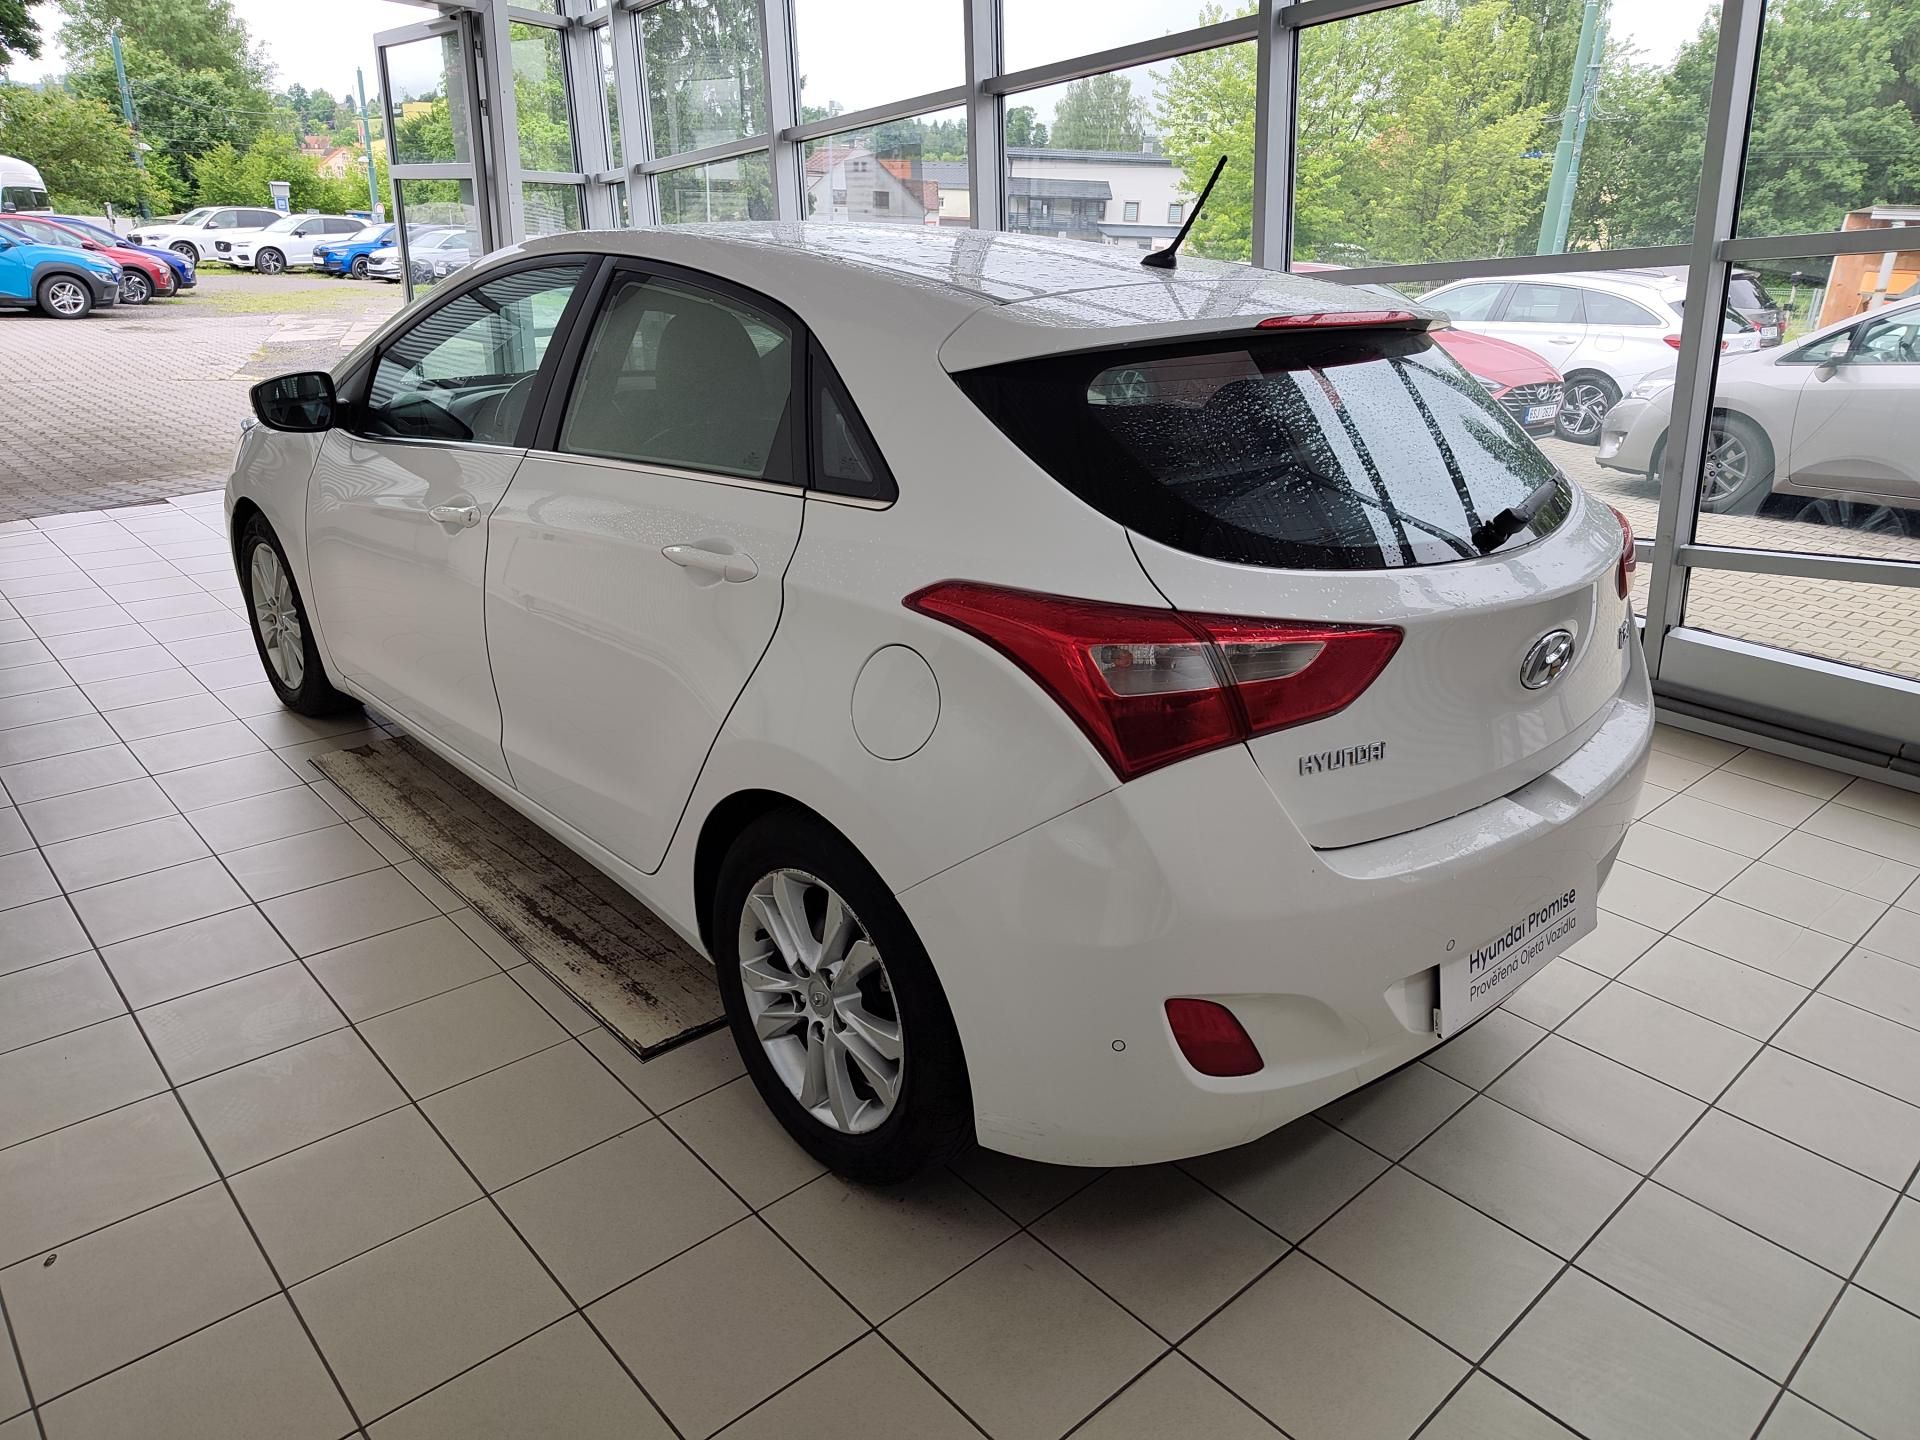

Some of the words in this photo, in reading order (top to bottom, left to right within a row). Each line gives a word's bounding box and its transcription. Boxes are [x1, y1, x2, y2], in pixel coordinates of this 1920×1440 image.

[1299, 741, 1386, 776] HYUNDAI
[1469, 919, 1526, 974] Hyundai
[1528, 888, 1576, 933] Promise
[1470, 957, 1519, 1002] Prověřená
[1520, 937, 1544, 965] Ojetá
[1545, 917, 1576, 946] Vozidla
